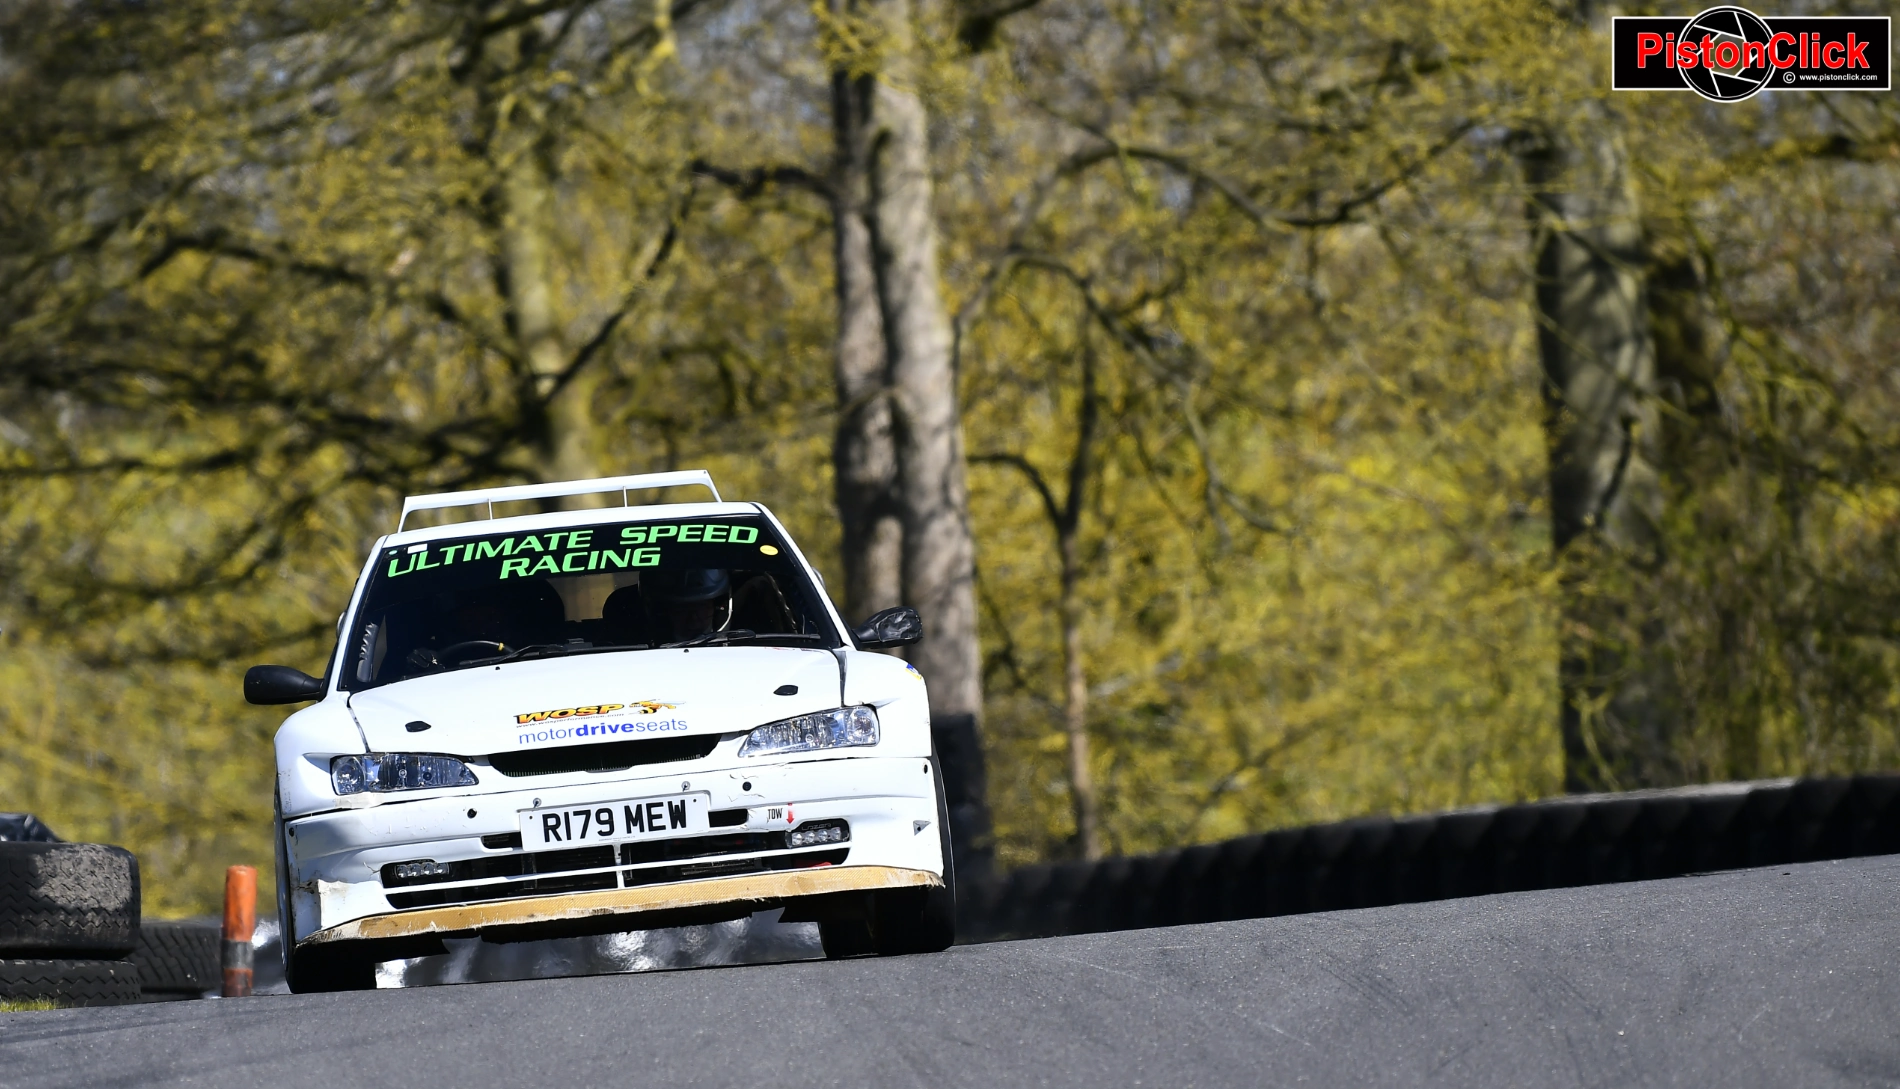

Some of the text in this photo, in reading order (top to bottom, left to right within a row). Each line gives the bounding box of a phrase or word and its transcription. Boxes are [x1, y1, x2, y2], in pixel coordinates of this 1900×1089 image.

[387, 524, 759, 578] ULTIMATE SPEED
[499, 547, 662, 580] RACING
[513, 703, 625, 725] WOSP
[518, 718, 688, 744] motordriveseats
[541, 799, 688, 843] R179 MEW
[767, 808, 783, 820] TOW
